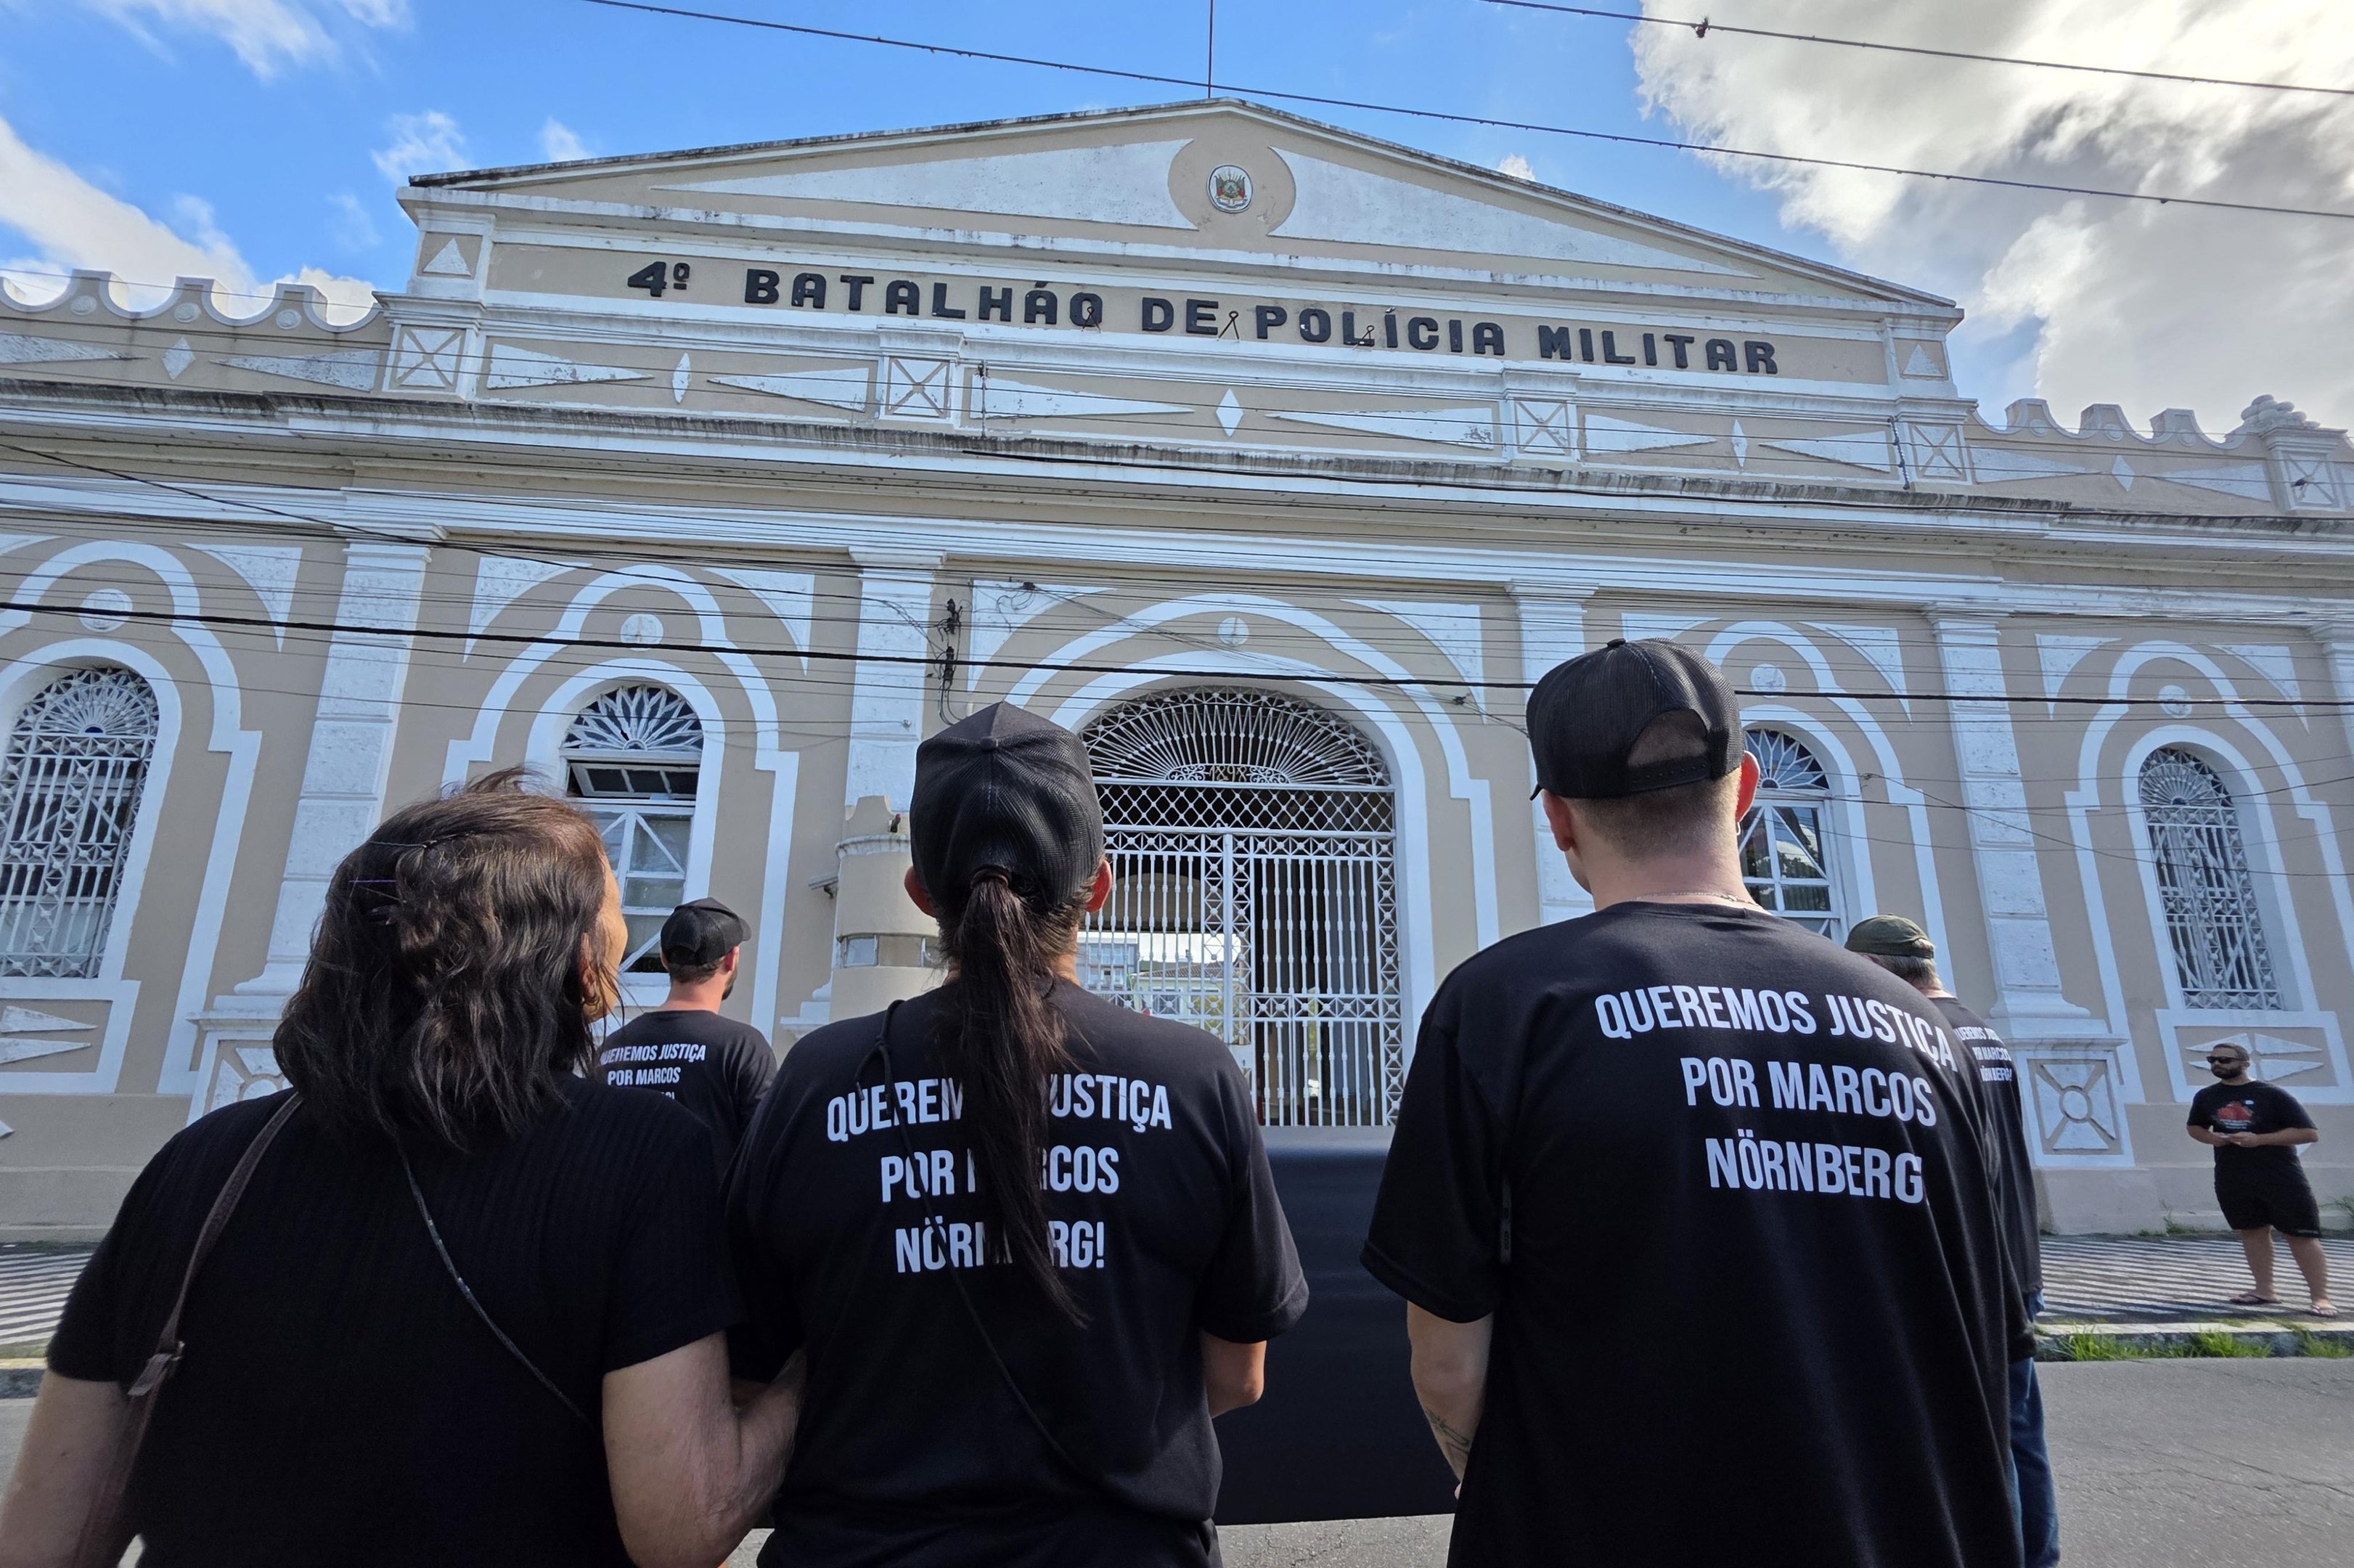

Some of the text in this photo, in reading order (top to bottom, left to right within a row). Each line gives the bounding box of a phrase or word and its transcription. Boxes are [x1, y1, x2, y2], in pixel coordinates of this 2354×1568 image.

[628, 261, 690, 298] 4º
[1141, 297, 1220, 336] DE
[1255, 305, 1505, 356] POLÍCIA
[1537, 324, 1778, 375] MILITAR
[658, 1043, 706, 1063] JUSTIÇA
[1595, 985, 1958, 1072] QUEREMOS JUSTIÇA
[607, 1066, 682, 1086] POR MARCOS
[827, 1073, 1172, 1142] QUEREM USTIÇA
[1680, 1057, 1937, 1127] POR MARCOS
[880, 1150, 955, 1203] POR
[1705, 1128, 1924, 1204] NÖRNBERG
